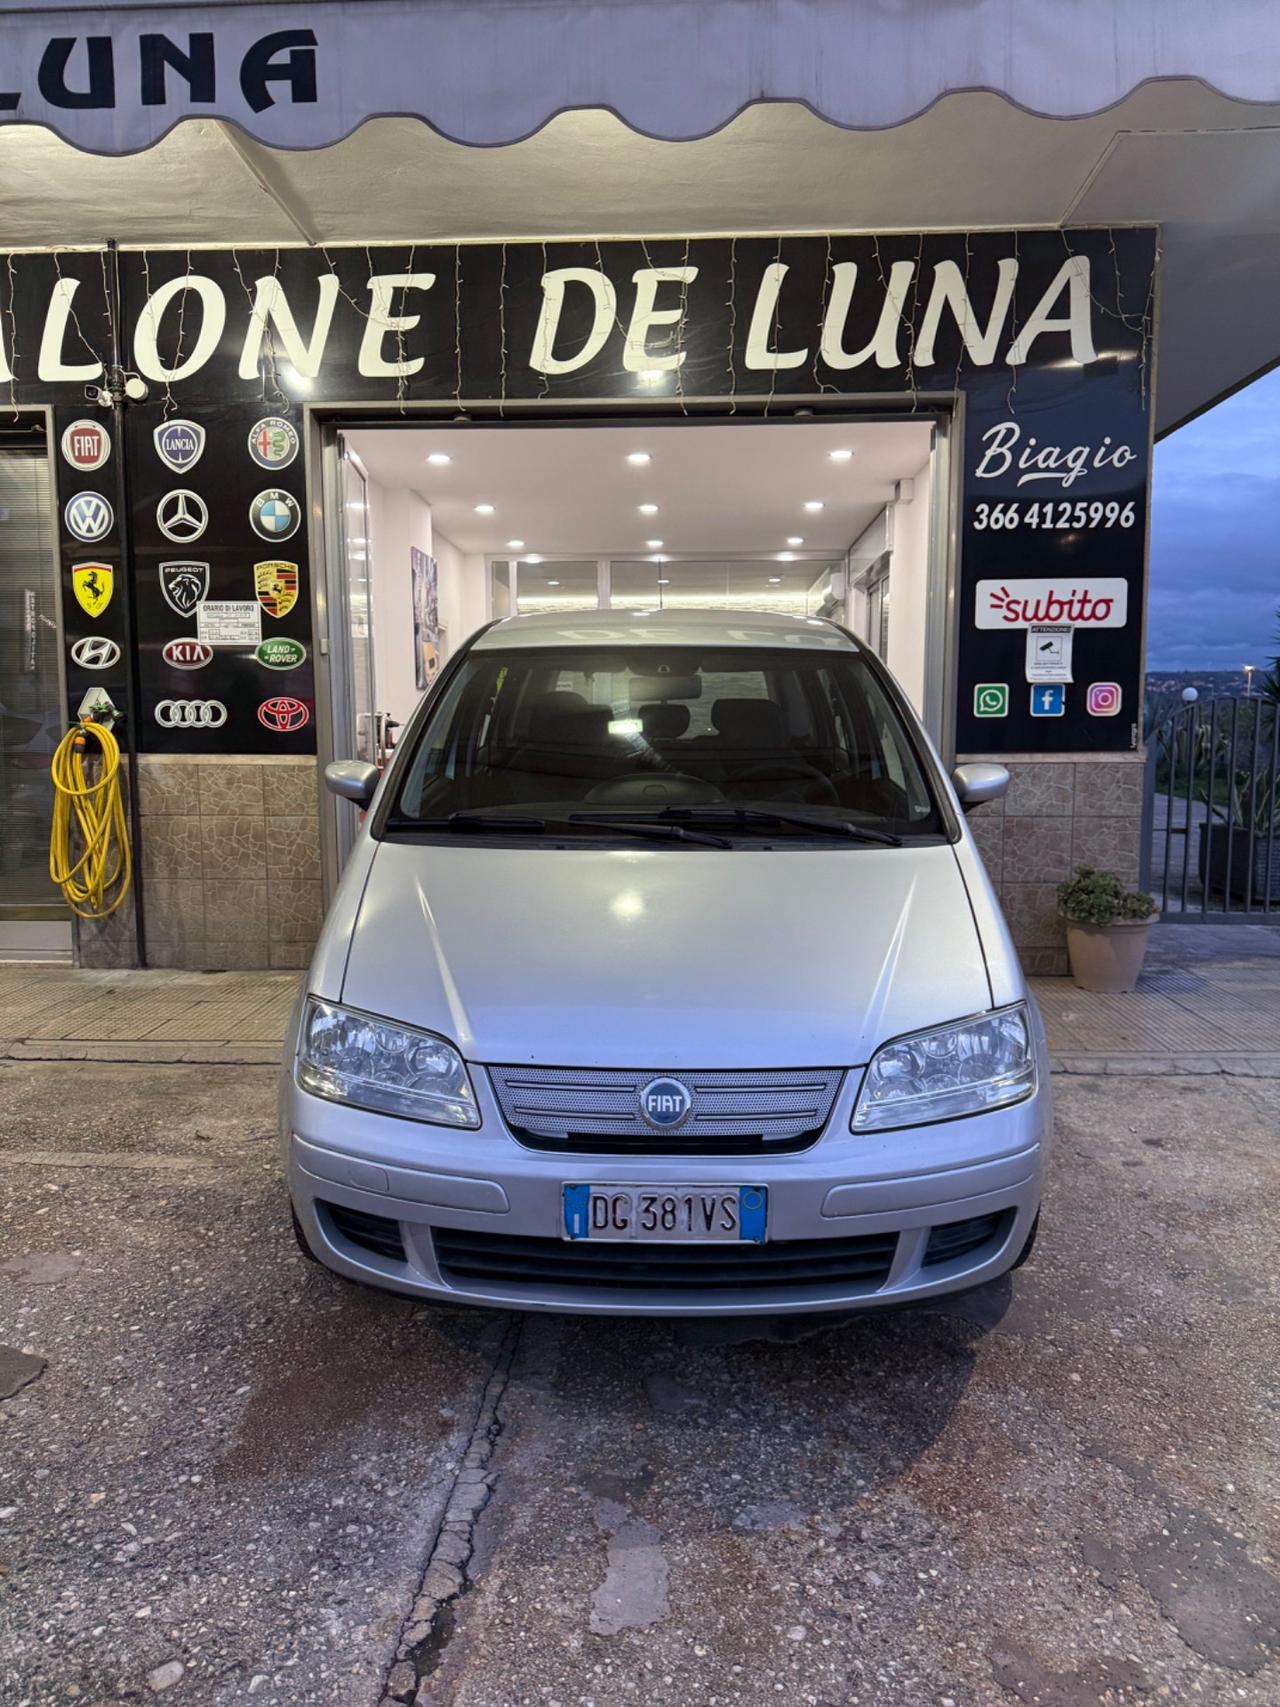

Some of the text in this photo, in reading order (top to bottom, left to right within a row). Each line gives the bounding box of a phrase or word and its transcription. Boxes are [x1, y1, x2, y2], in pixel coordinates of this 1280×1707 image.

[0, 29, 318, 112] UNA
[0, 255, 1098, 382] LONE DE LUNA
[269, 420, 297, 445] ROMEO
[73, 435, 100, 457] FIAT
[166, 438, 194, 451] LANCIA
[975, 420, 1137, 489] Biagio
[256, 492, 295, 508] BMW
[973, 500, 1136, 530] 366 4125996
[164, 566, 205, 574] PEUGEOT
[1002, 588, 1115, 623] subito
[171, 645, 206, 661] KIA
[267, 644, 290, 654] LAND
[269, 654, 298, 663] ROVER
[648, 1095, 683, 1112] FIAT
[592, 1194, 629, 1230] DG
